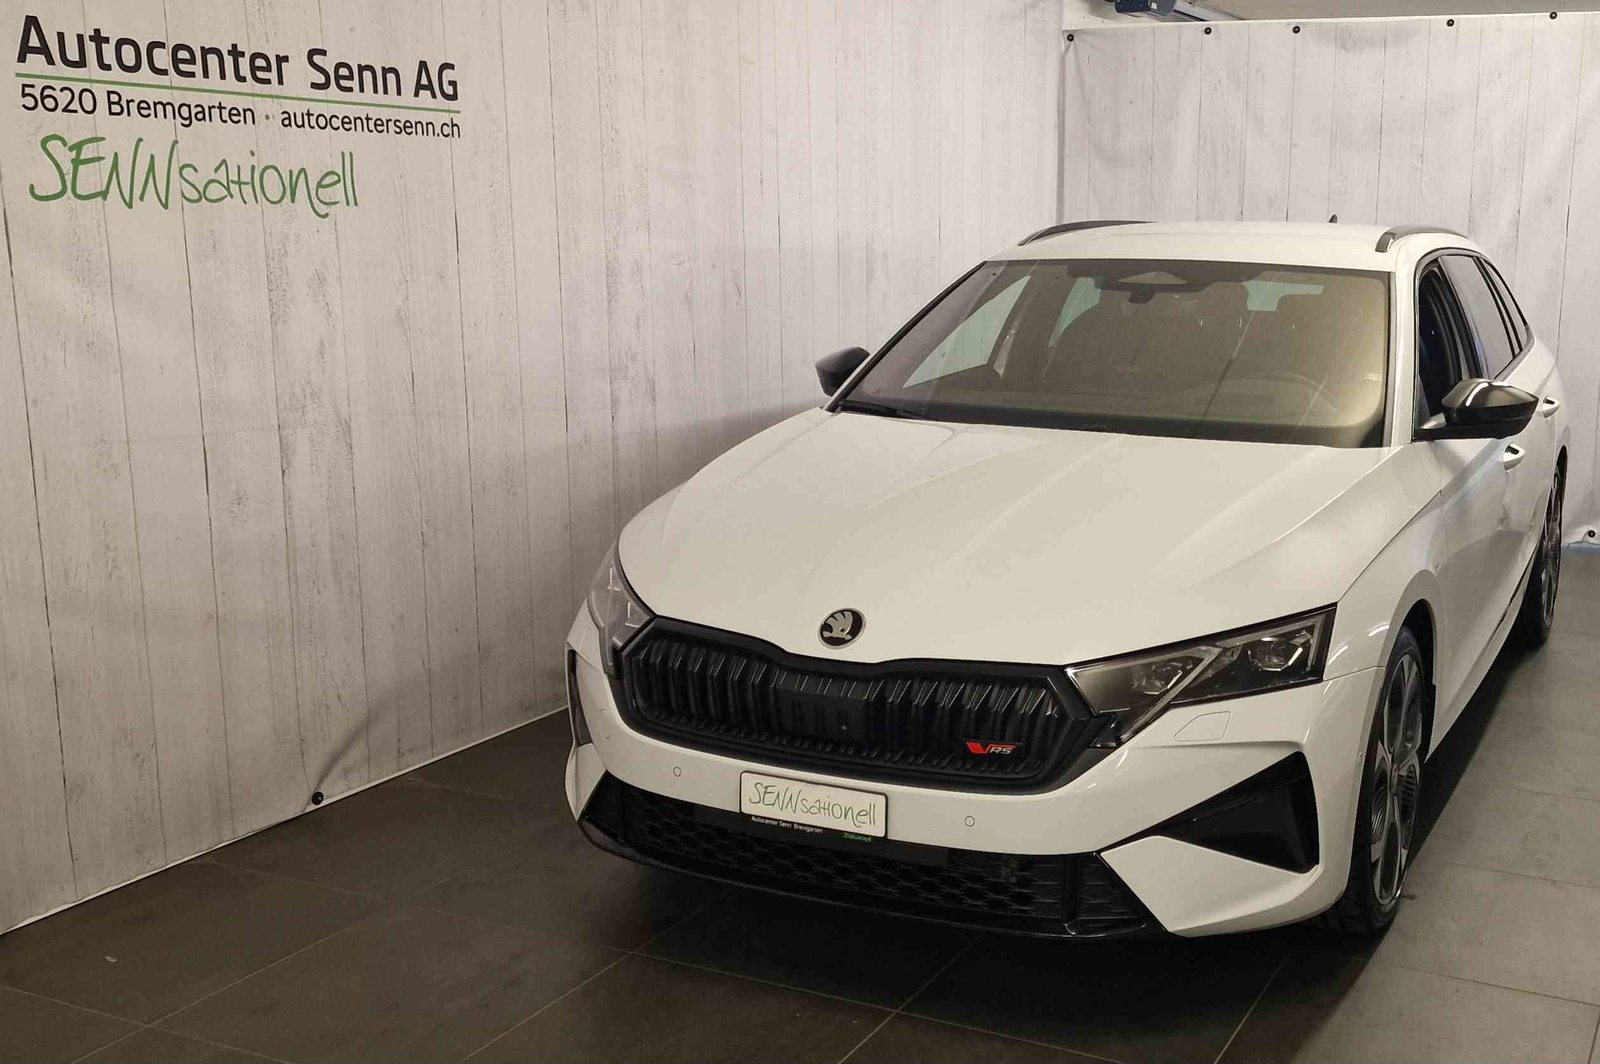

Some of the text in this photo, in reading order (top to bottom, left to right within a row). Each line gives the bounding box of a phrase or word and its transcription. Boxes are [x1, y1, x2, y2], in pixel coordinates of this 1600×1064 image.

[17, 15, 460, 102] Autocenter Senn AG
[20, 84, 462, 139] 5620 Bremgarten autocentersenn.ch
[29, 134, 359, 219] SENNsationell
[748, 782, 877, 829] SENNsationell
[751, 815, 824, 834] Autocenter Senn Bremgarten
